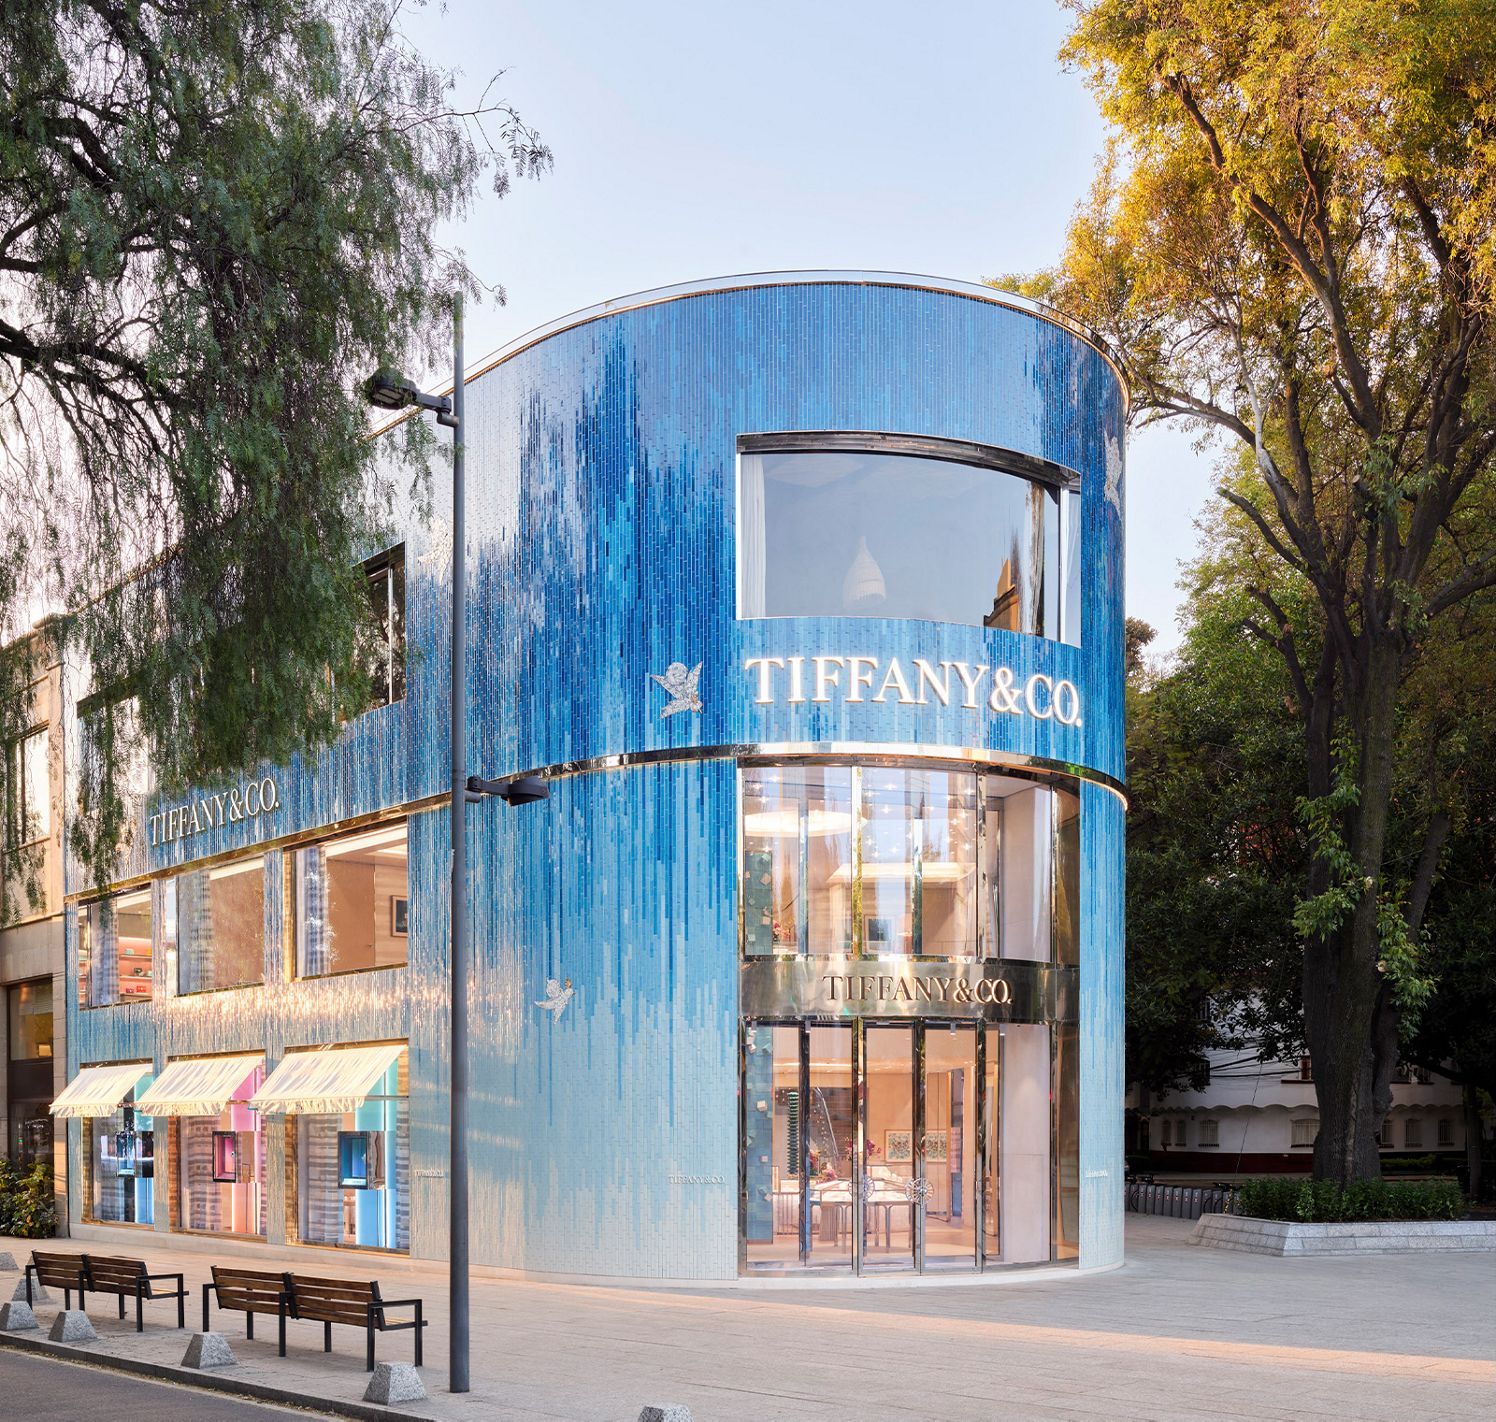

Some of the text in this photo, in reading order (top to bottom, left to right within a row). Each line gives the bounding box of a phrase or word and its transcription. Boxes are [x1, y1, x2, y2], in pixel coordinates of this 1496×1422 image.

[745, 656, 1083, 728] TIFFANY&CO.
[149, 777, 280, 846] TIFFANY&CO.
[822, 975, 1014, 1004] TIFFANY&CO.
